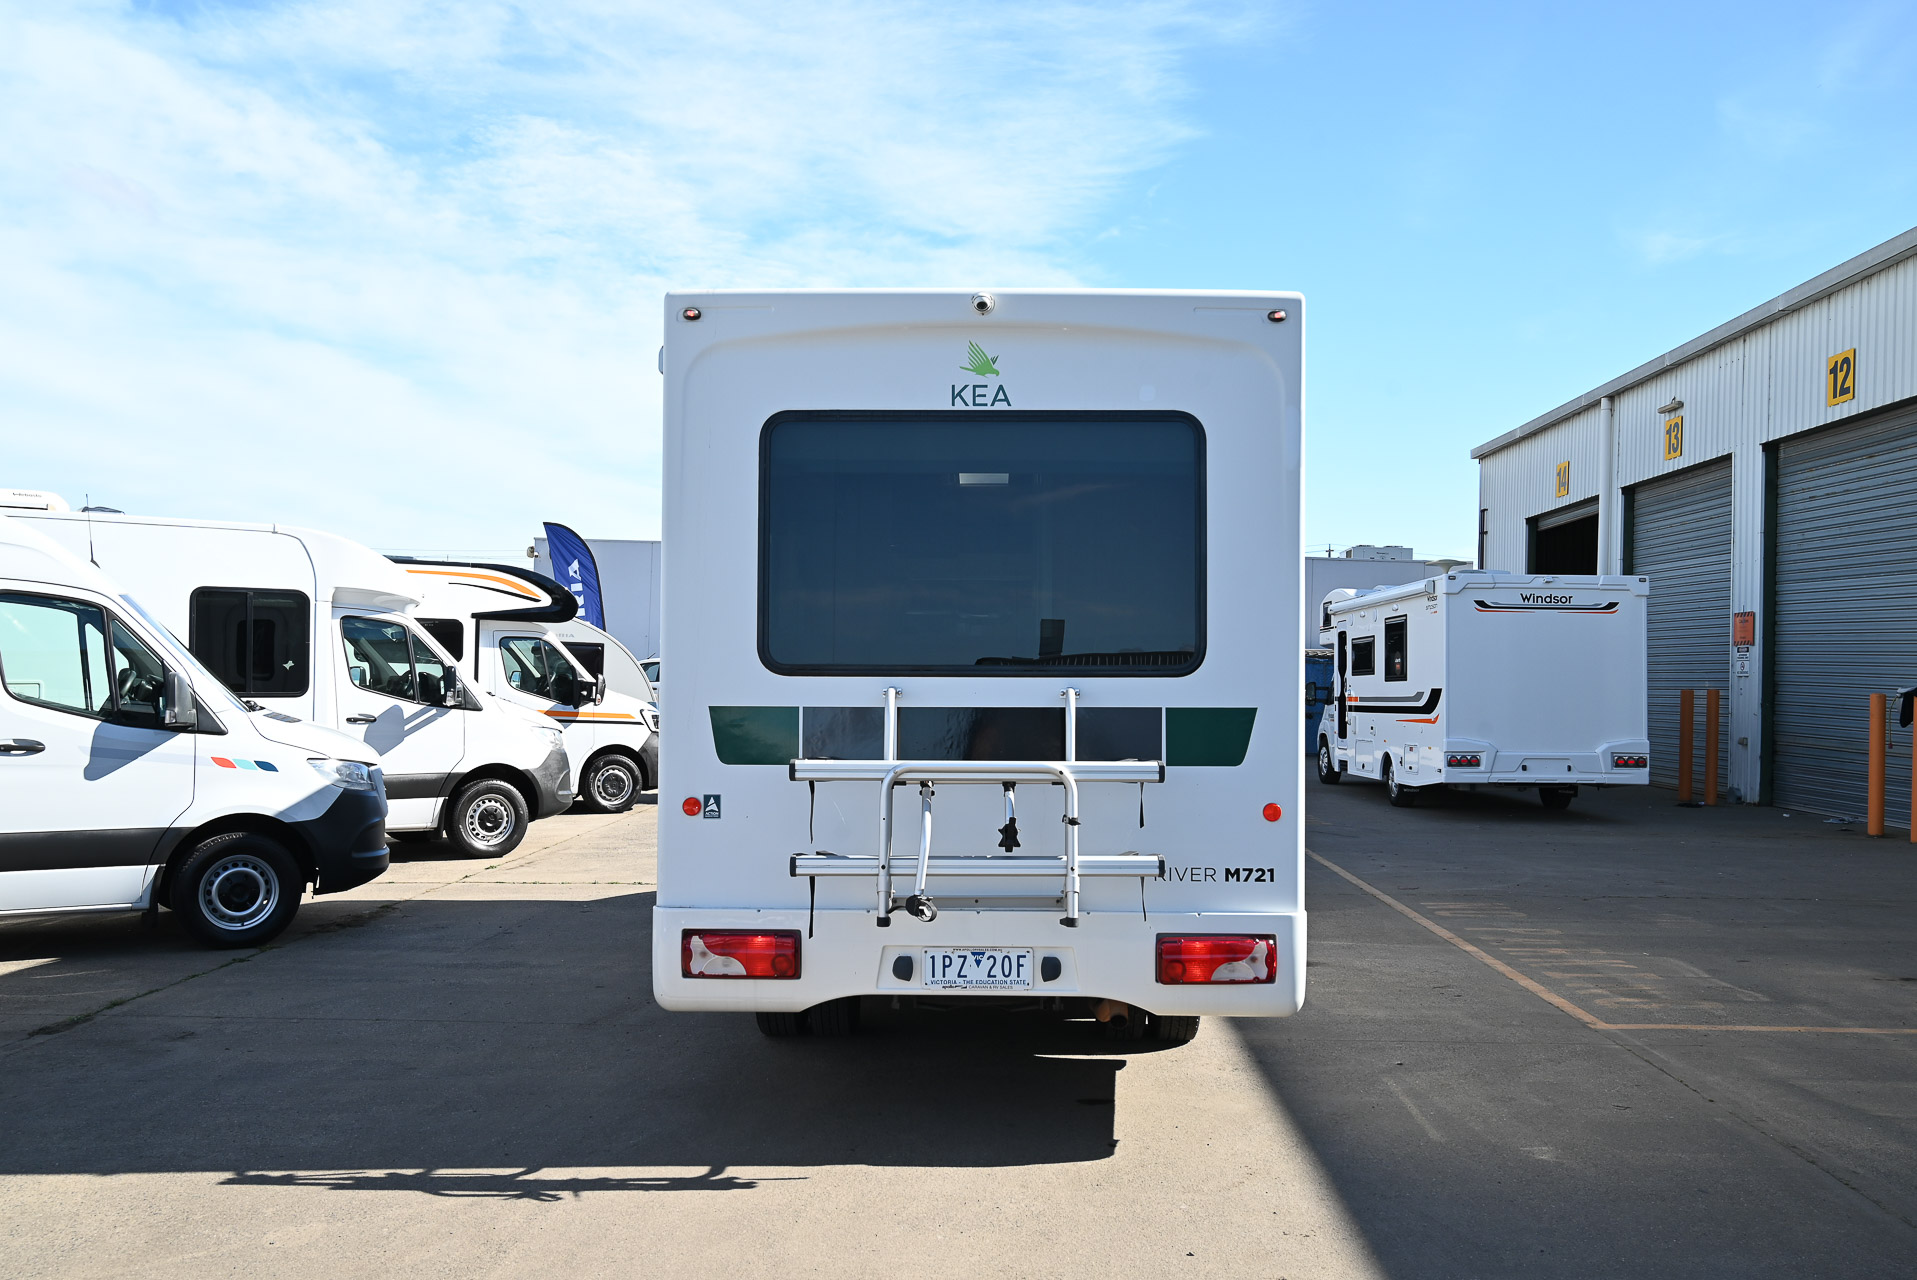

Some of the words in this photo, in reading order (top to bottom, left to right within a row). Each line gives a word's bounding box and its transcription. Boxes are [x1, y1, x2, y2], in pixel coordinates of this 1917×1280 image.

[1829, 357, 1851, 399] 12
[951, 384, 1012, 406] KEA
[1666, 422, 1680, 455] 13
[1556, 466, 1567, 493] 14
[1520, 593, 1573, 604] Windsor
[1224, 868, 1275, 882] M721
[930, 955, 968, 978] 1PZ
